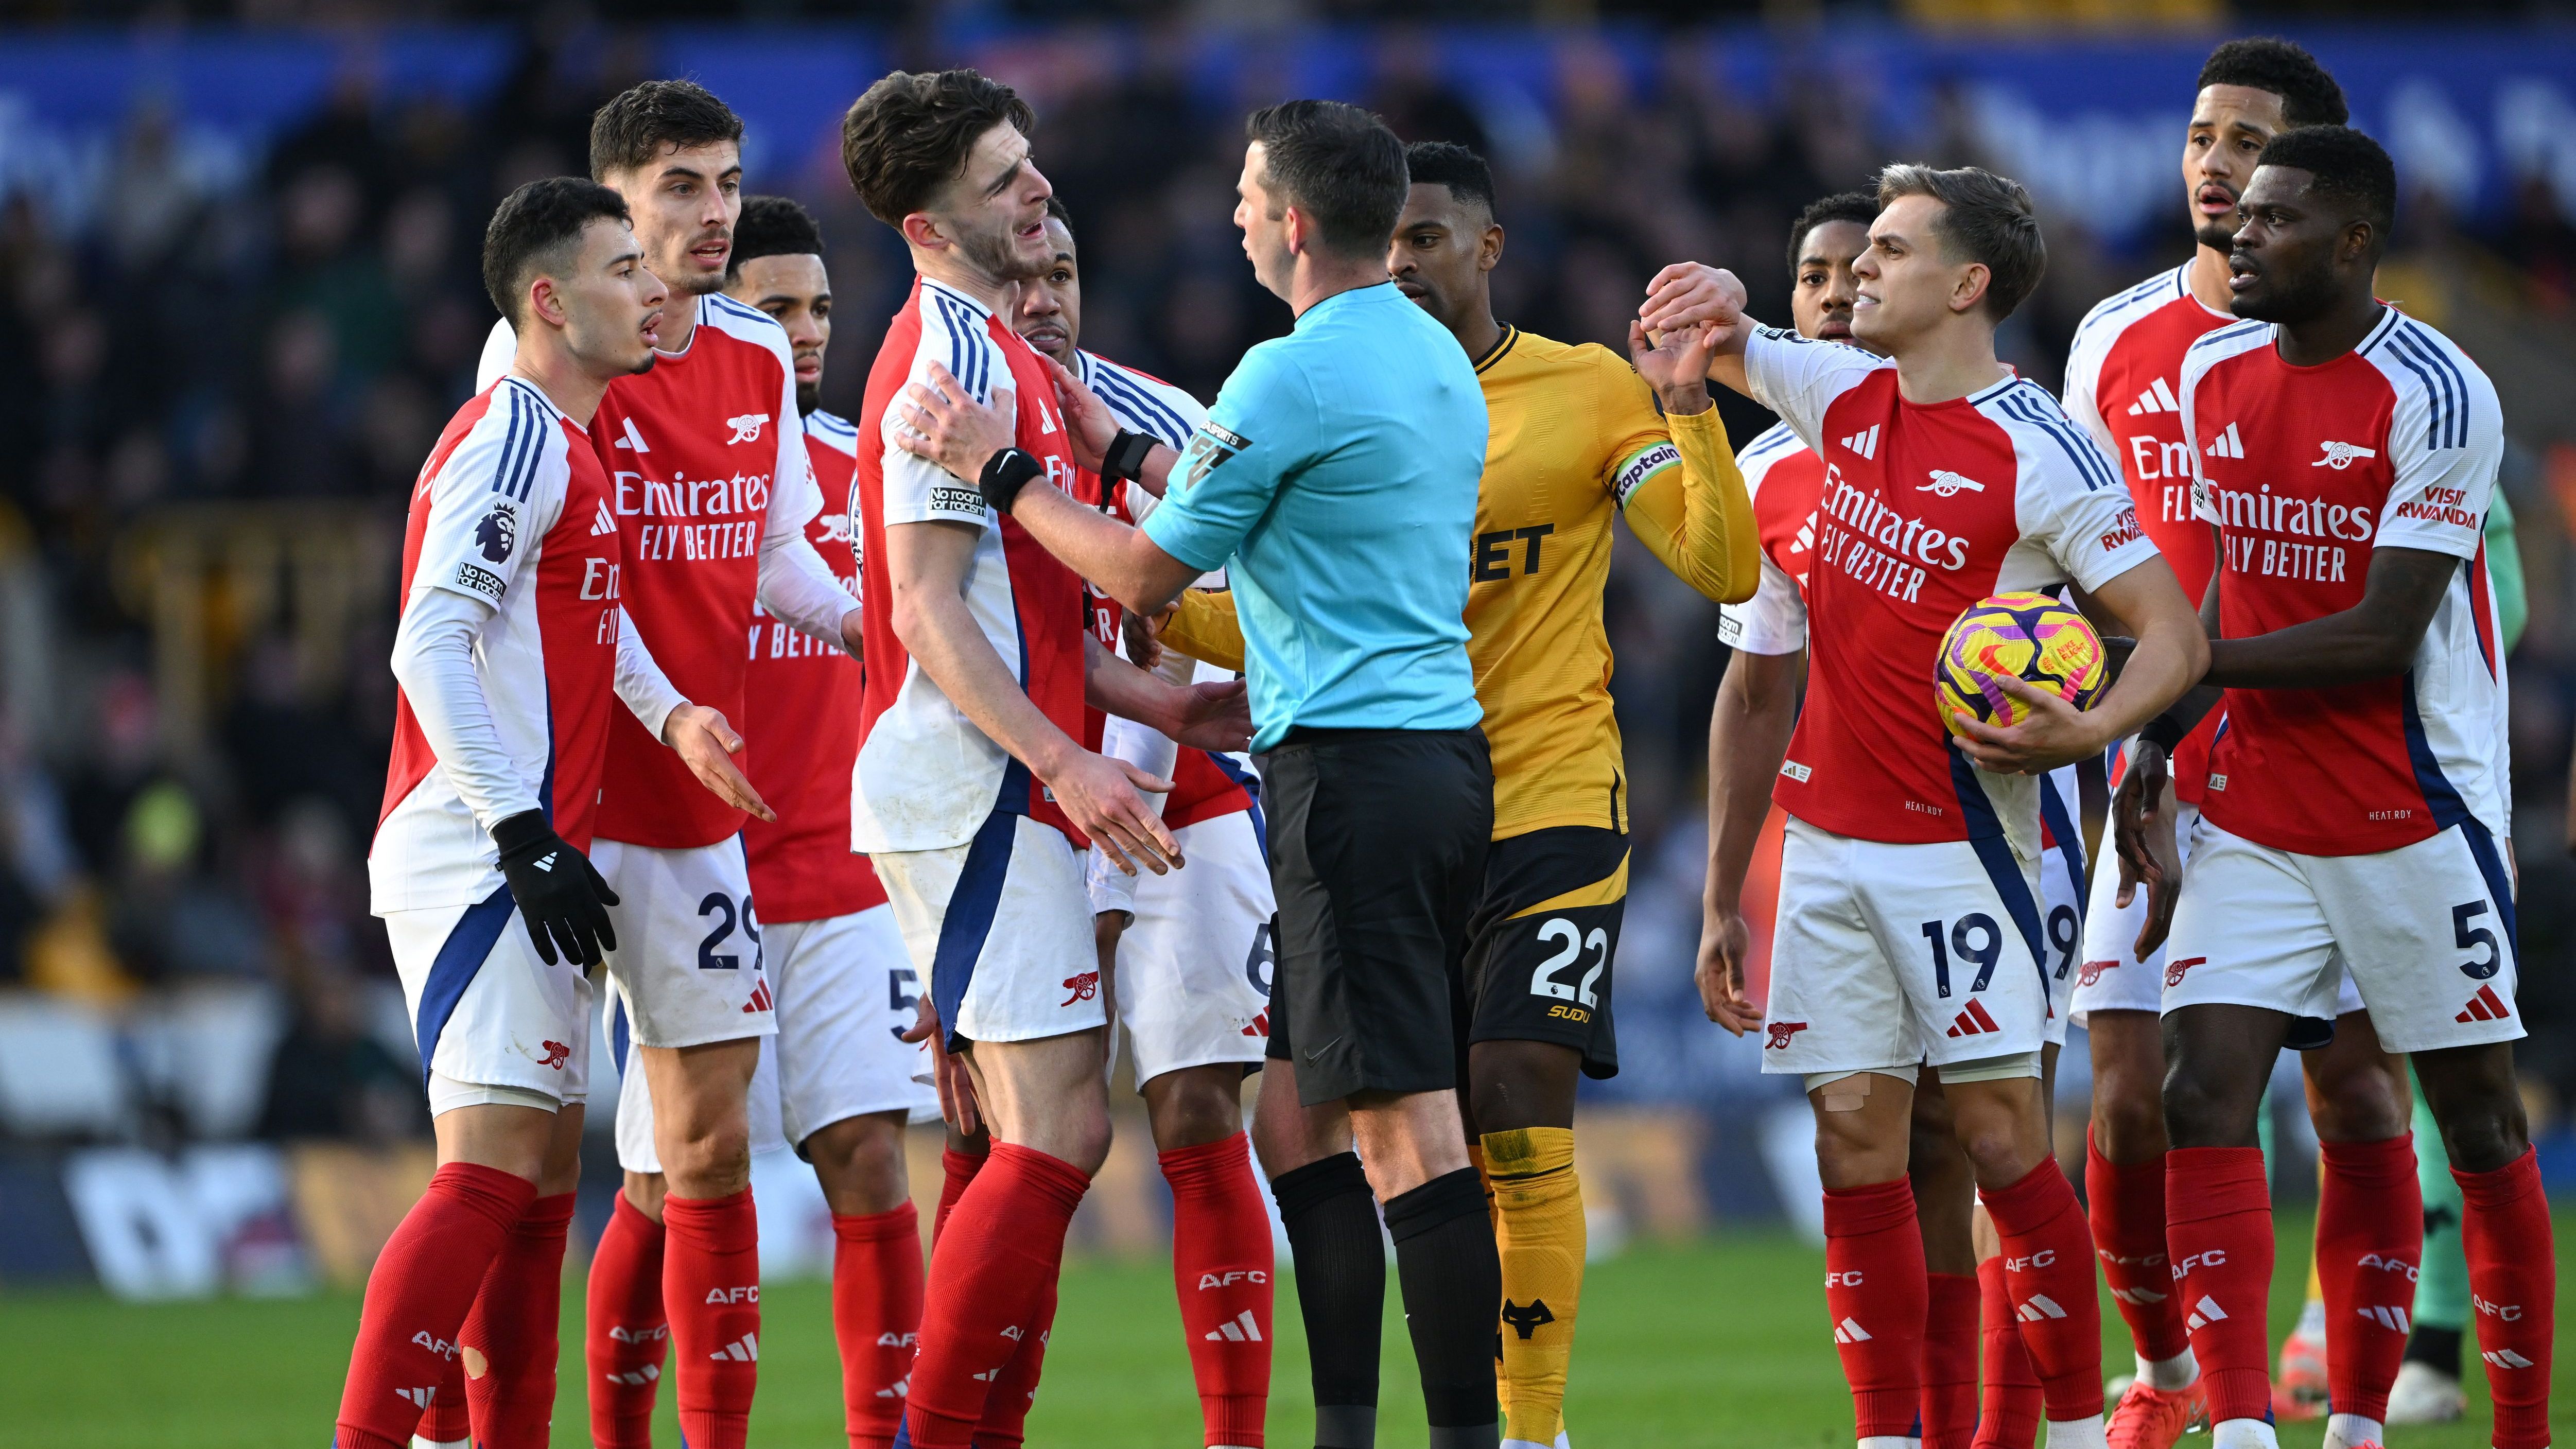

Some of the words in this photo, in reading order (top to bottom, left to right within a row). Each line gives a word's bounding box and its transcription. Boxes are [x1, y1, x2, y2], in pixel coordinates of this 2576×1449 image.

[1617, 446, 1680, 496] Captain
[614, 470, 770, 516] Emirates
[930, 488, 949, 500] No
[951, 491, 983, 505] room
[930, 498, 948, 510] for
[949, 500, 986, 517] racism
[2425, 486, 2467, 506] VISIT
[1821, 462, 1970, 570] Emirates
[2396, 502, 2476, 530] RWANDA
[640, 525, 678, 560] FLY
[684, 520, 756, 560] BETTER
[1822, 523, 1850, 566] FLY
[1844, 540, 1926, 603] BETTER
[2225, 534, 2256, 573] FLY
[2261, 539, 2345, 582] BETTER
[456, 572, 475, 587] for
[476, 581, 502, 604] racism
[458, 563, 478, 578] No
[479, 571, 503, 594] room
[2057, 640, 2076, 655] NIKE
[2061, 642, 2086, 661] FLIGHT
[1905, 800, 1942, 816] HEAT.RDY
[2369, 809, 2411, 820] HEAT.RDY
[698, 892, 763, 970] 29
[2452, 899, 2501, 980] 5
[1530, 918, 1607, 1010] 22
[1922, 913, 2002, 998] 19
[890, 969, 920, 1042] 5
[1547, 1005, 1590, 1023] SUDU
[2006, 1249, 2055, 1272] AFC
[2172, 1249, 2226, 1282] AFC
[2358, 1253, 2420, 1283] AFC
[706, 1286, 759, 1304] AFC
[1199, 1270, 1266, 1290] AFC
[2473, 1293, 2522, 1321] AFC
[412, 1330, 456, 1361] AFC
[610, 1322, 668, 1345] AFC
